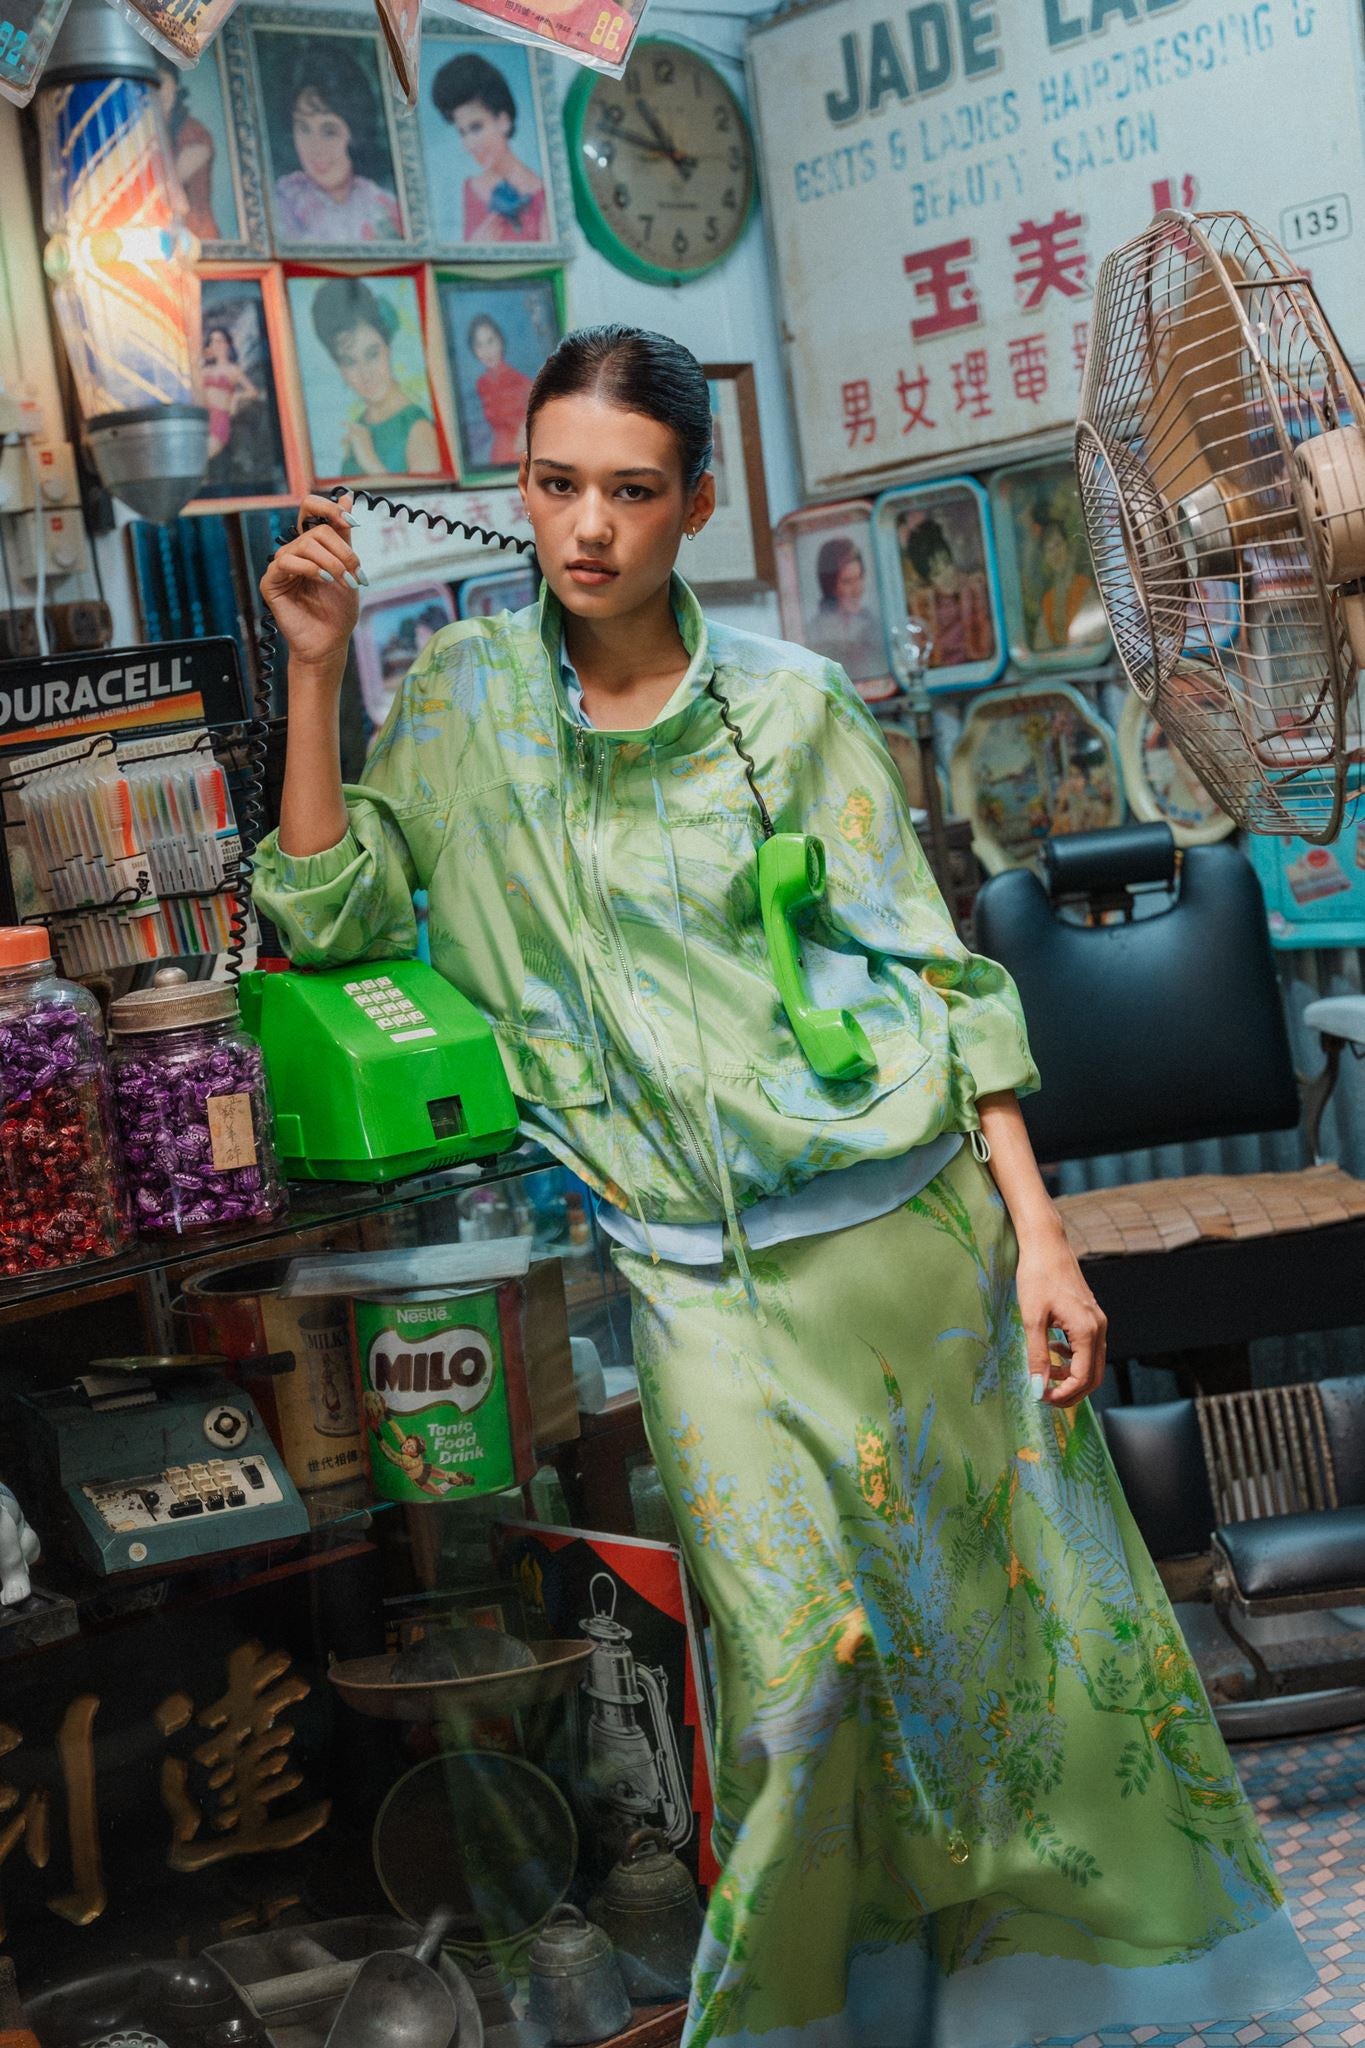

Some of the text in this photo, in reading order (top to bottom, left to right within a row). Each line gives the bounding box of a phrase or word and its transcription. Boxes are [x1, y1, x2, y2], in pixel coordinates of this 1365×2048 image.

[824, 0, 998, 124] JADE
[1292, 203, 1339, 240] 135
[375, 1346, 488, 1393] MILO
[427, 1420, 473, 1437] Tonic
[434, 1432, 476, 1450] Food
[439, 1446, 484, 1465] Drink
